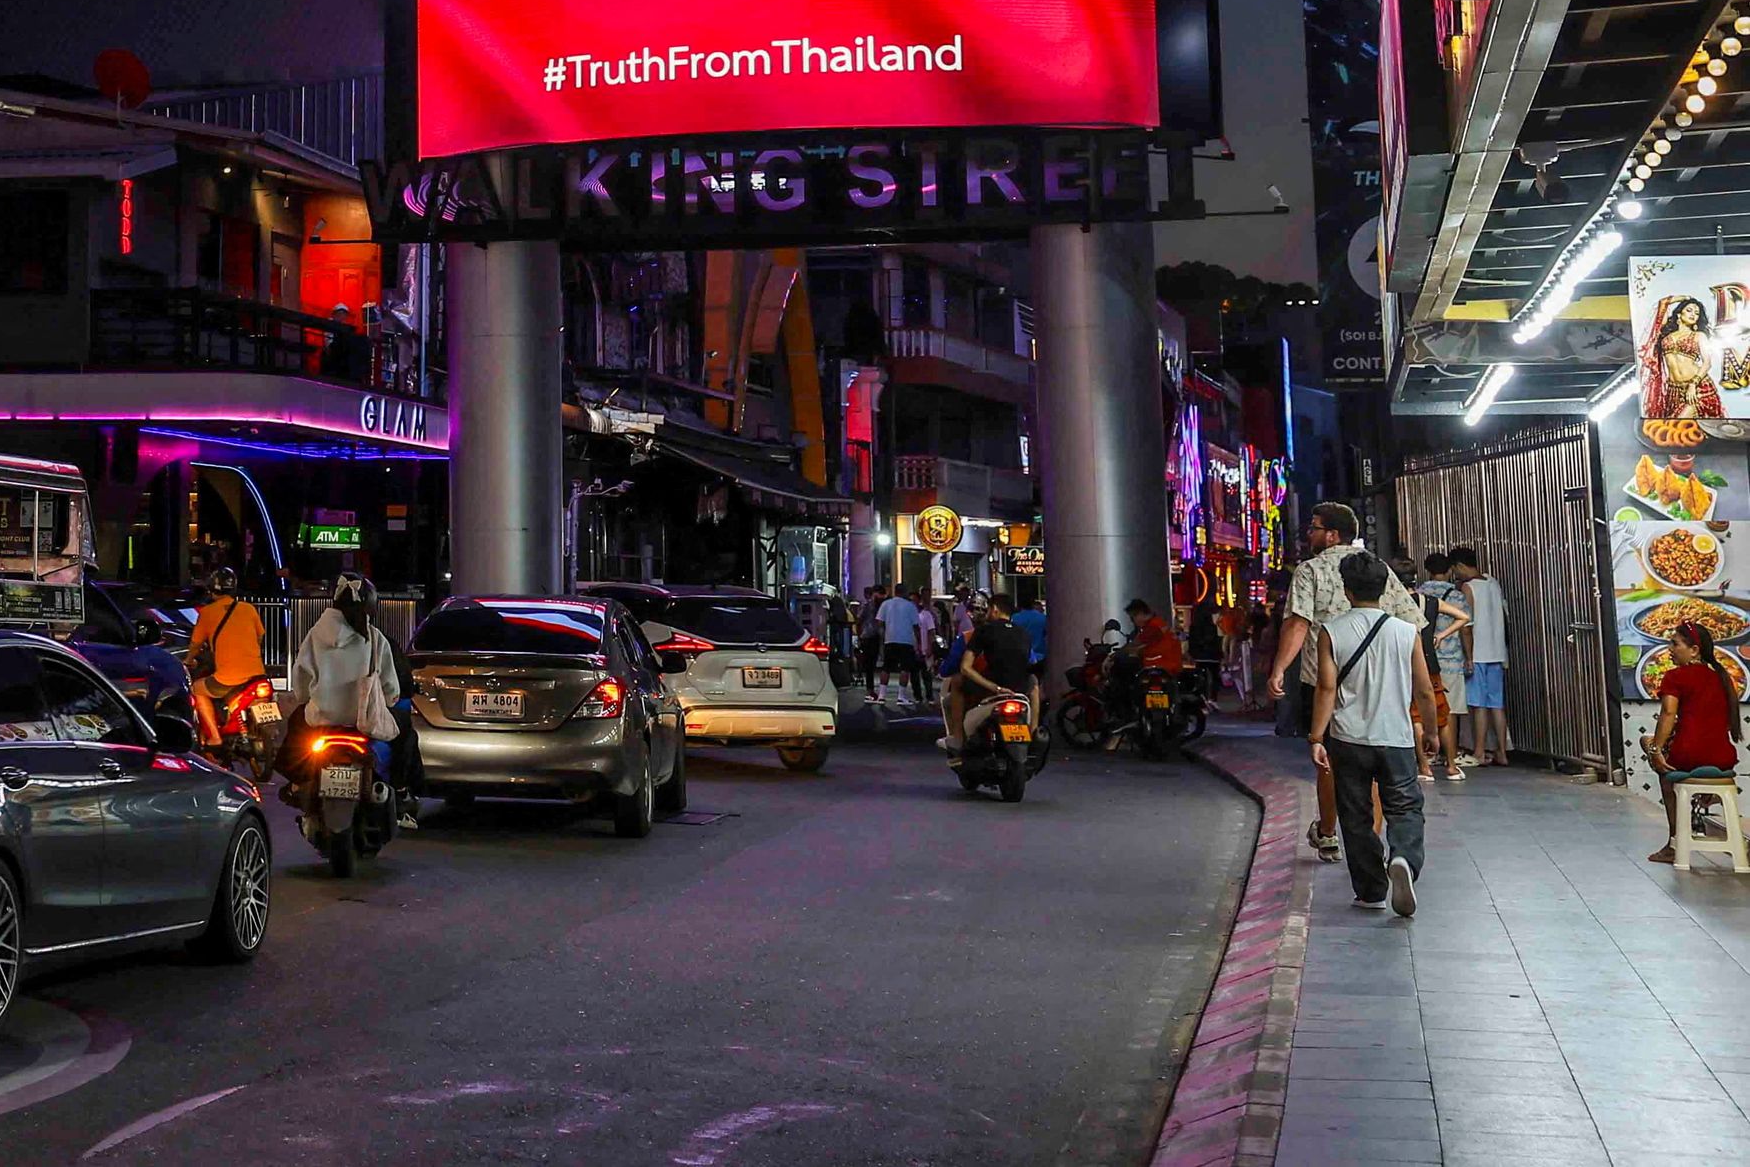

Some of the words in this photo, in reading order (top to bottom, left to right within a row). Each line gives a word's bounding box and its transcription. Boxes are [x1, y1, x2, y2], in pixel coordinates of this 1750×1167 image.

[543, 34, 963, 92] #TruthFromThailand
[364, 147, 807, 230] WALKING
[846, 135, 1207, 219] STREET
[361, 395, 427, 442] GLAM
[316, 531, 339, 542] ATM
[1008, 547, 1028, 562] The
[493, 695, 519, 707] 4804
